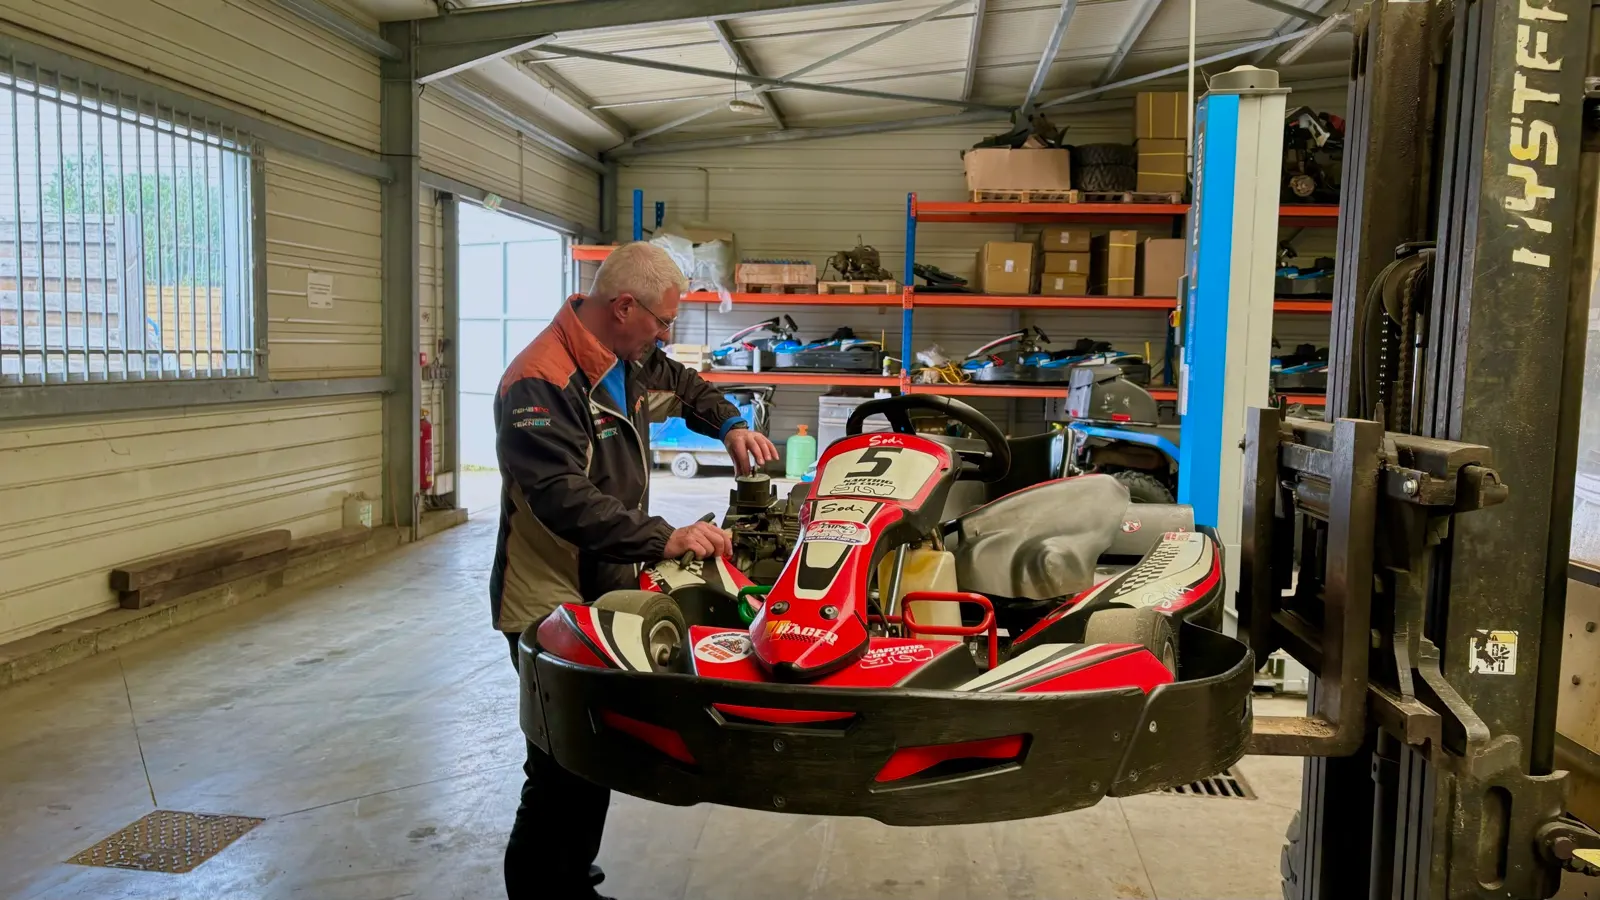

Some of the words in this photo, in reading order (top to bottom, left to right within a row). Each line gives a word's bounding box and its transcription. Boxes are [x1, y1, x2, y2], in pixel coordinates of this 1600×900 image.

[869, 435, 904, 446] Sodi
[844, 447, 903, 478] 5
[821, 502, 865, 514] Sodi
[776, 623, 839, 646] RACER
[868, 644, 924, 655] KARTING
